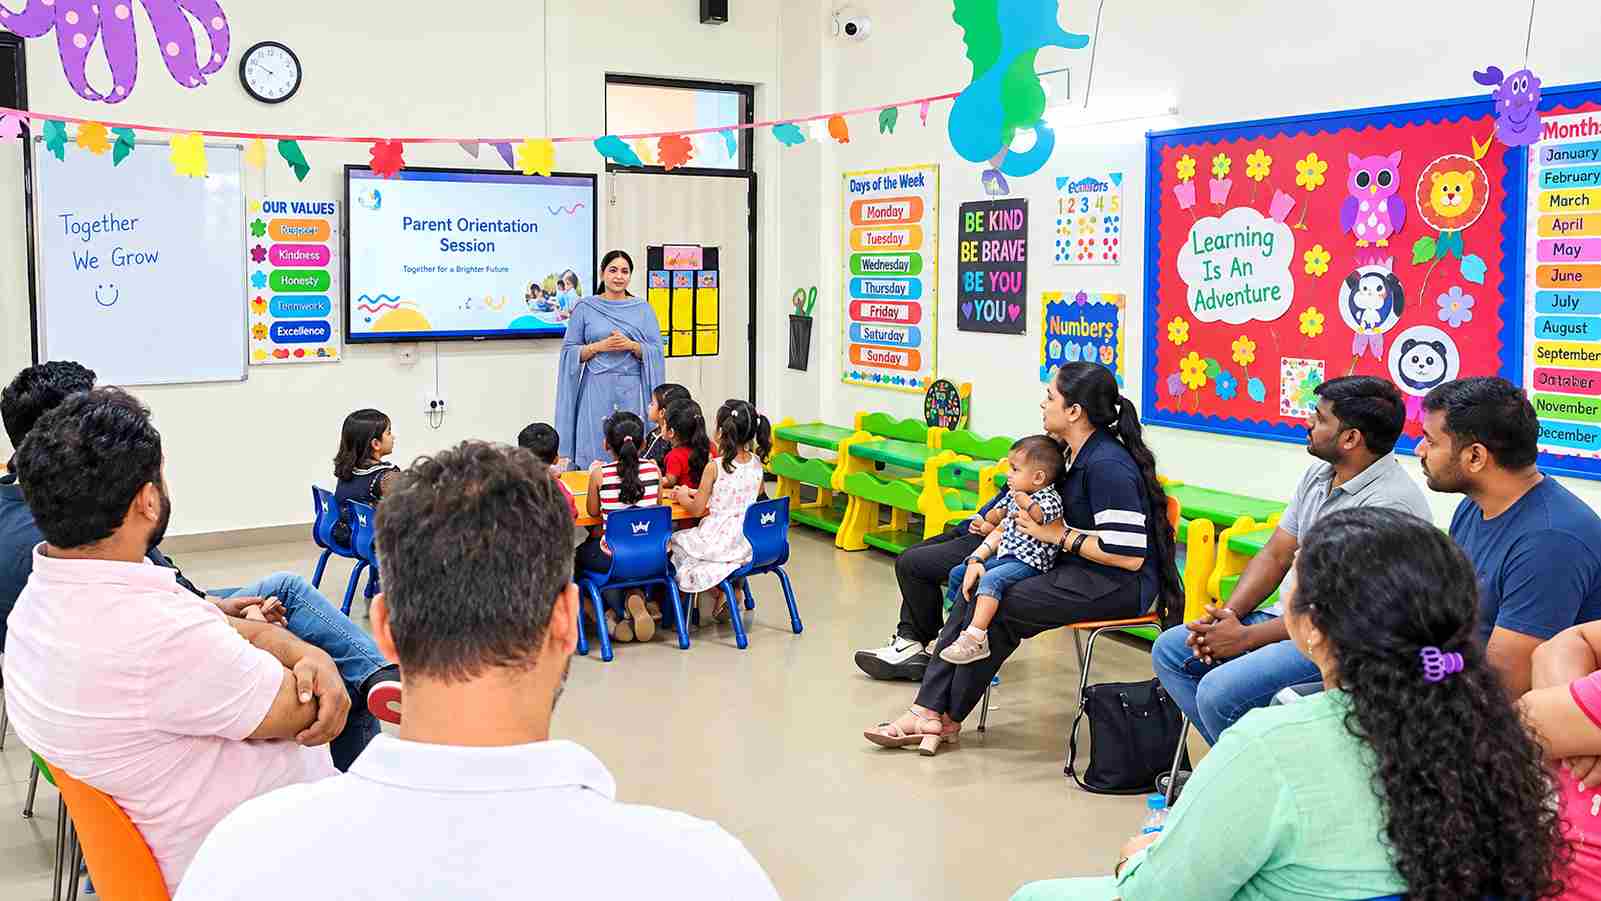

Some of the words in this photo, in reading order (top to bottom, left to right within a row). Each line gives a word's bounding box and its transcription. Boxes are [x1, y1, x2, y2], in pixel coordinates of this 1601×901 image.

[1546, 147, 1599, 162] January
[850, 178, 871, 194] Days
[873, 177, 881, 190] of
[883, 176, 897, 190] the
[899, 173, 925, 188] Week
[1544, 170, 1600, 185] February
[262, 200, 287, 214] OUR
[290, 201, 335, 215] VALUES
[1068, 197, 1076, 213] 2
[1080, 196, 1089, 213] 3
[1095, 195, 1104, 212] 4
[1110, 195, 1120, 213] 5
[1549, 193, 1590, 207] March
[866, 204, 904, 219] Monday
[59, 213, 140, 241] Together
[402, 217, 452, 231] Parent
[457, 218, 538, 233] Orientation
[965, 212, 984, 233] BE
[989, 208, 1024, 231] KIND
[1552, 217, 1584, 234] April
[440, 238, 496, 252] Session
[866, 231, 904, 246] Tuesday
[1192, 225, 1274, 257] Learning
[73, 251, 100, 270] We
[112, 246, 160, 267] Grow
[280, 249, 320, 261] Kindness
[960, 241, 978, 262] BE
[982, 239, 1025, 262] BRAVE
[1553, 243, 1582, 258] May
[403, 265, 436, 274] Together
[437, 265, 448, 273] for
[456, 265, 485, 274] Brighter
[862, 258, 909, 272] Wednesday
[1203, 260, 1221, 282] Is
[1230, 256, 1253, 278] An
[281, 275, 320, 287] Honesty
[964, 272, 984, 292] BE
[989, 271, 1022, 294] YOU
[1551, 269, 1583, 282] June
[865, 282, 906, 296] Thursday
[1194, 283, 1282, 312] Adventure
[1551, 294, 1580, 311] July
[869, 304, 899, 318] Friday
[974, 300, 1006, 323] YOU
[277, 325, 325, 336] Excellence
[1049, 315, 1114, 339] Numbers
[1542, 320, 1588, 337] August
[863, 328, 905, 343] Saturday
[866, 350, 902, 365] Sunday
[1537, 347, 1601, 363] September
[1536, 398, 1598, 415] November
[1536, 425, 1598, 443] December
